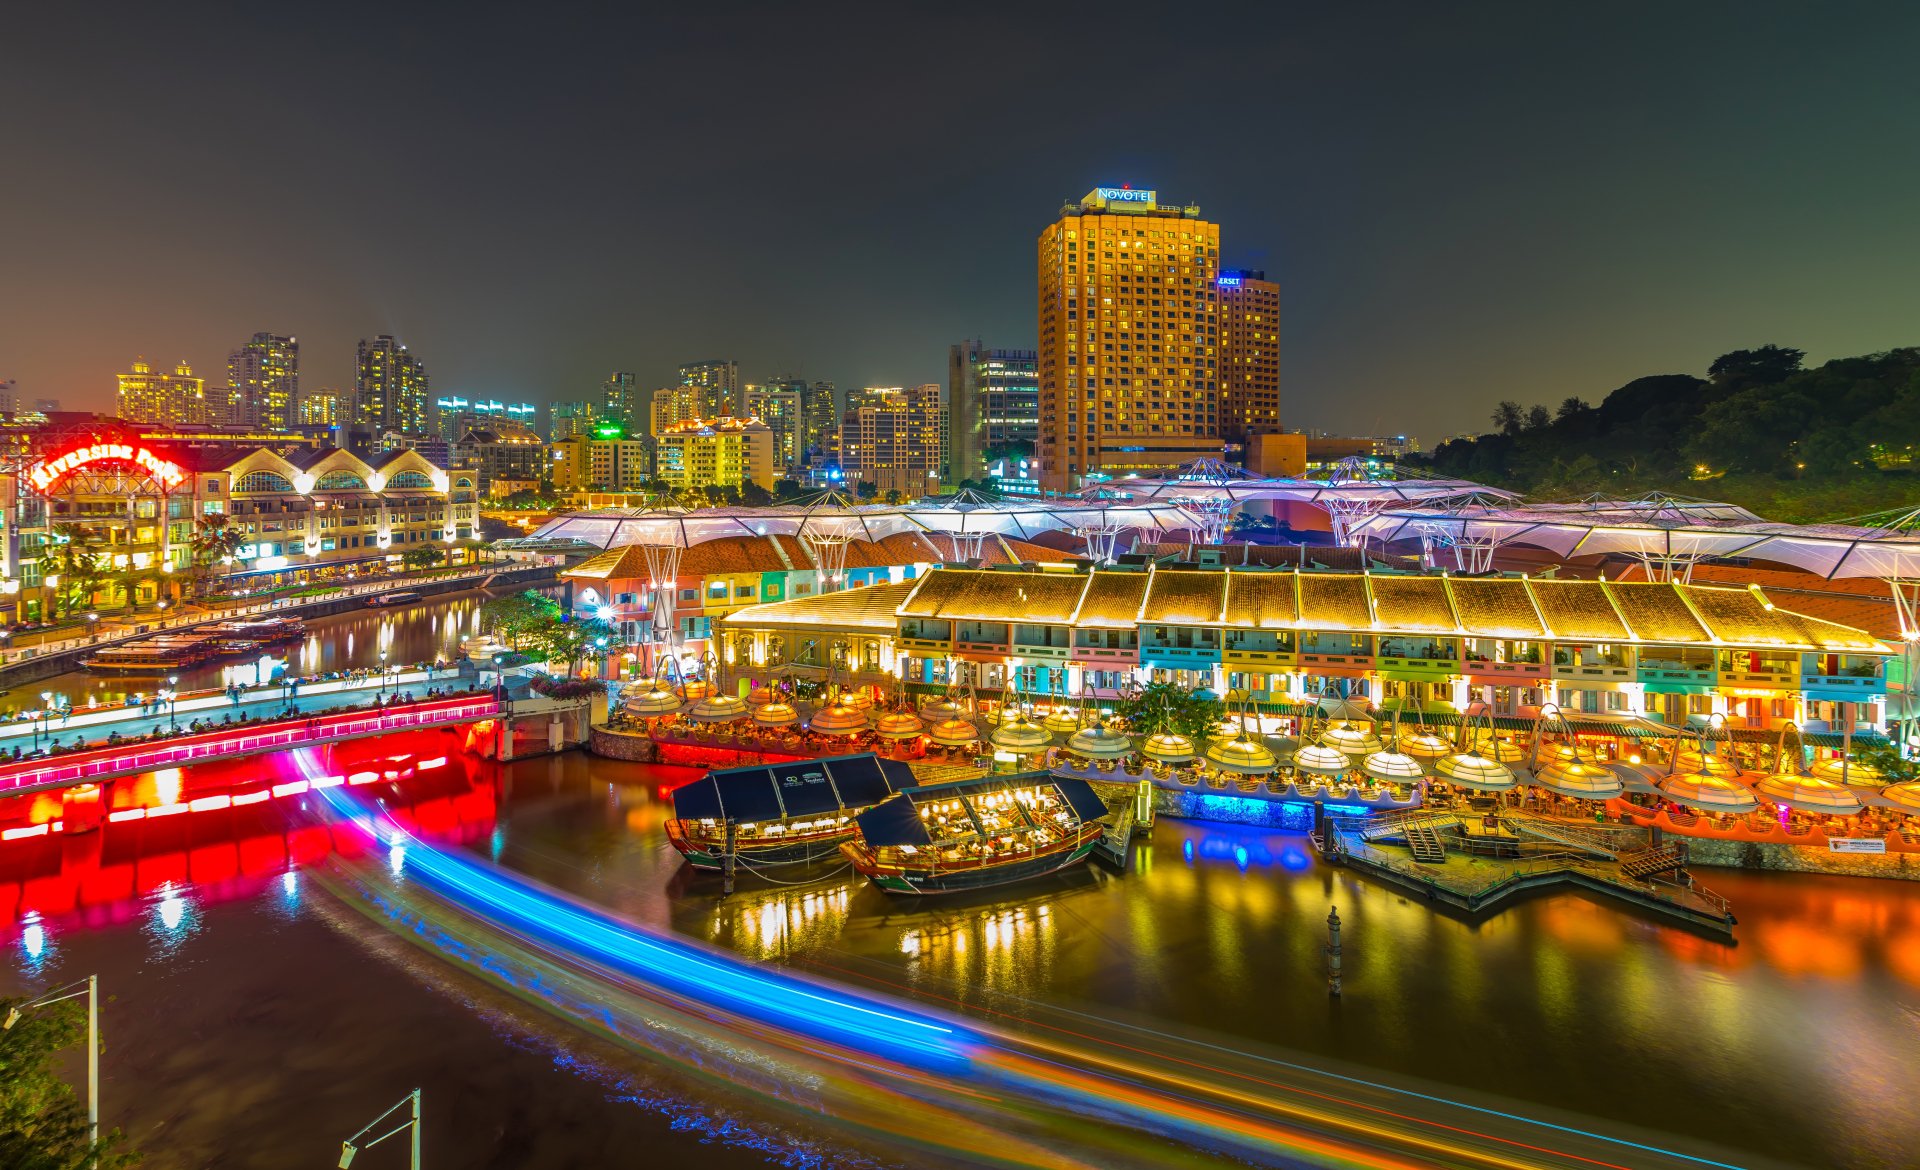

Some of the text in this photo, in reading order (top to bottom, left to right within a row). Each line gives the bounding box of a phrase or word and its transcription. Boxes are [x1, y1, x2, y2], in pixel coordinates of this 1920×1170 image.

[1098, 189, 1154, 201] NOVOTEL
[31, 444, 183, 489] RIVERSIDE POINT
